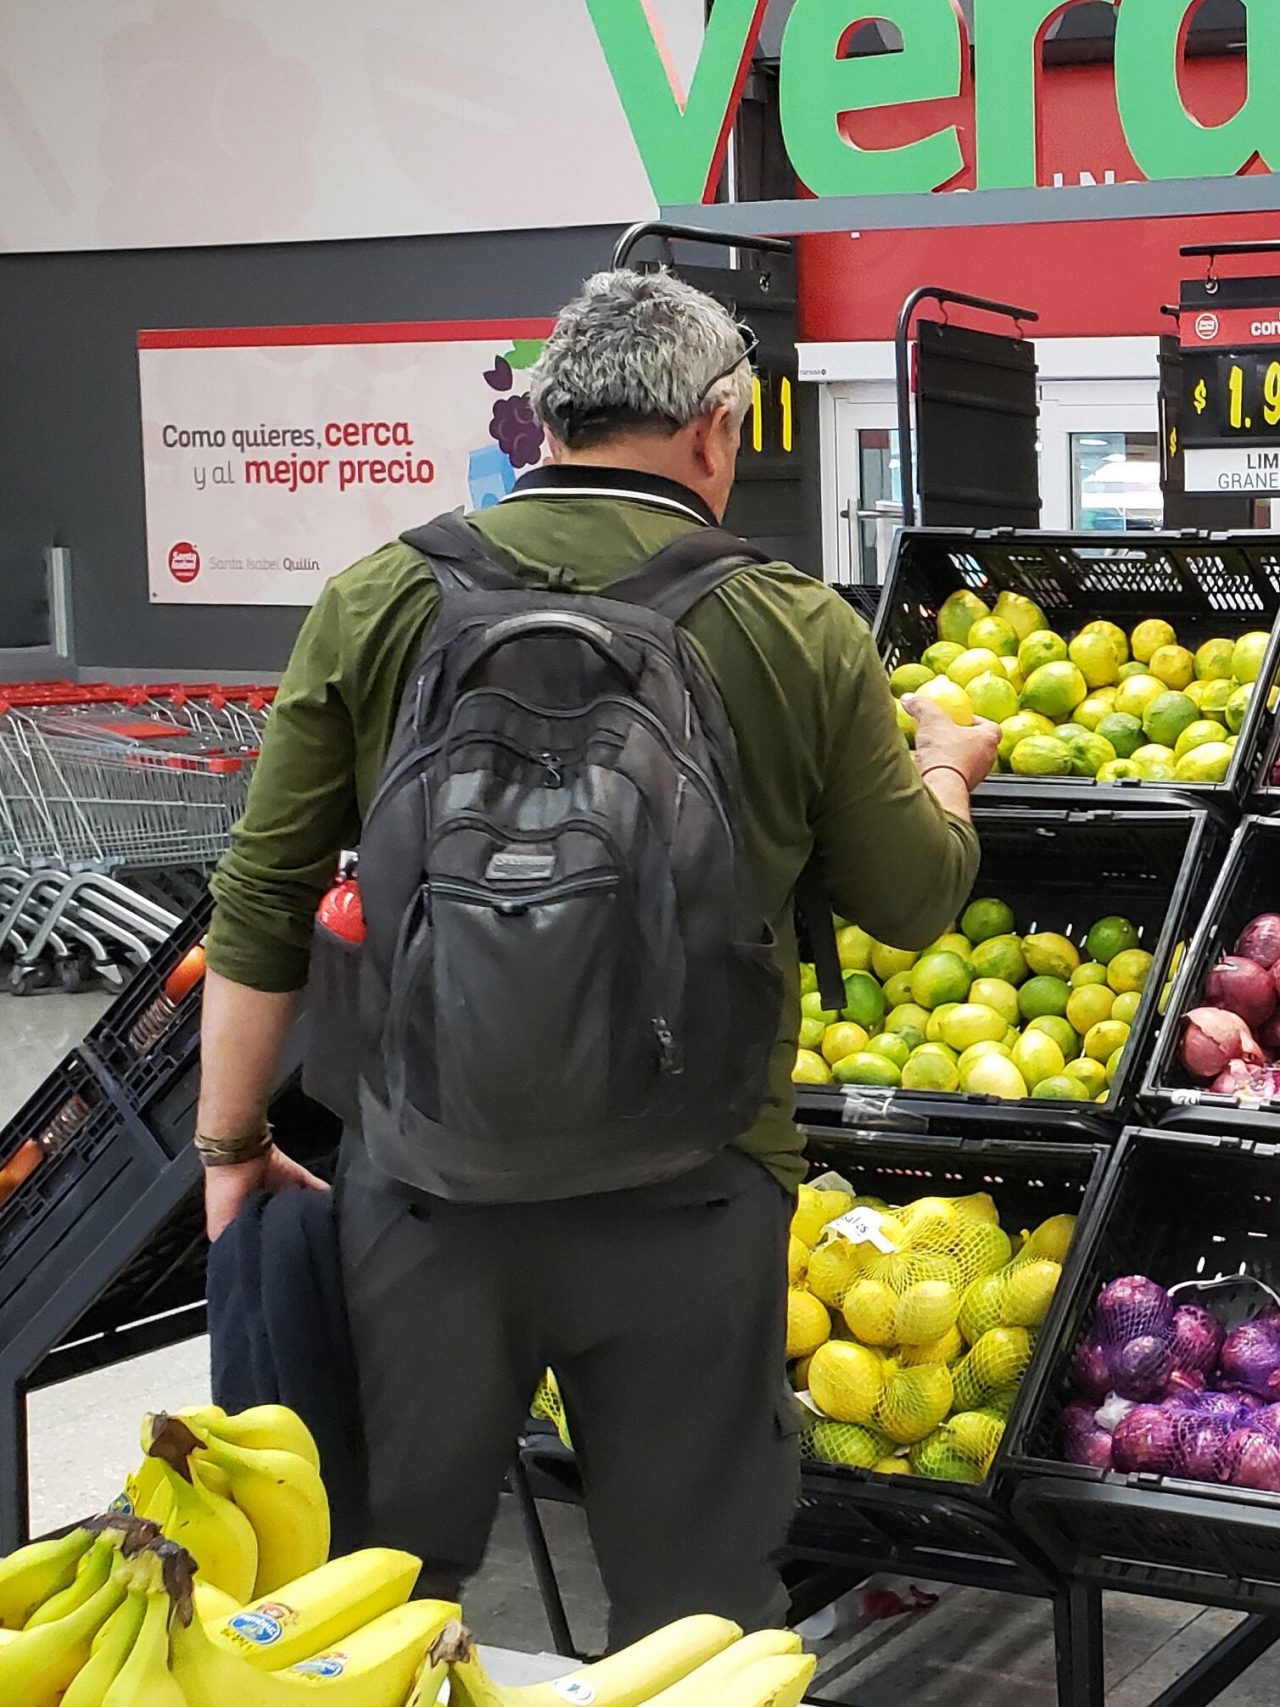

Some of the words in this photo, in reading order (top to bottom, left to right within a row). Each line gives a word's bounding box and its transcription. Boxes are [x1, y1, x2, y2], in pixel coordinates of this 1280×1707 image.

[1193, 379, 1207, 415] $
[162, 424, 226, 448] Como
[232, 423, 322, 453] quieres,
[324, 421, 414, 447] cerca
[194, 465, 206, 490] y
[212, 460, 235, 484] al
[245, 452, 330, 492] mejor
[338, 451, 435, 492] precio
[209, 556, 244, 571] Santa
